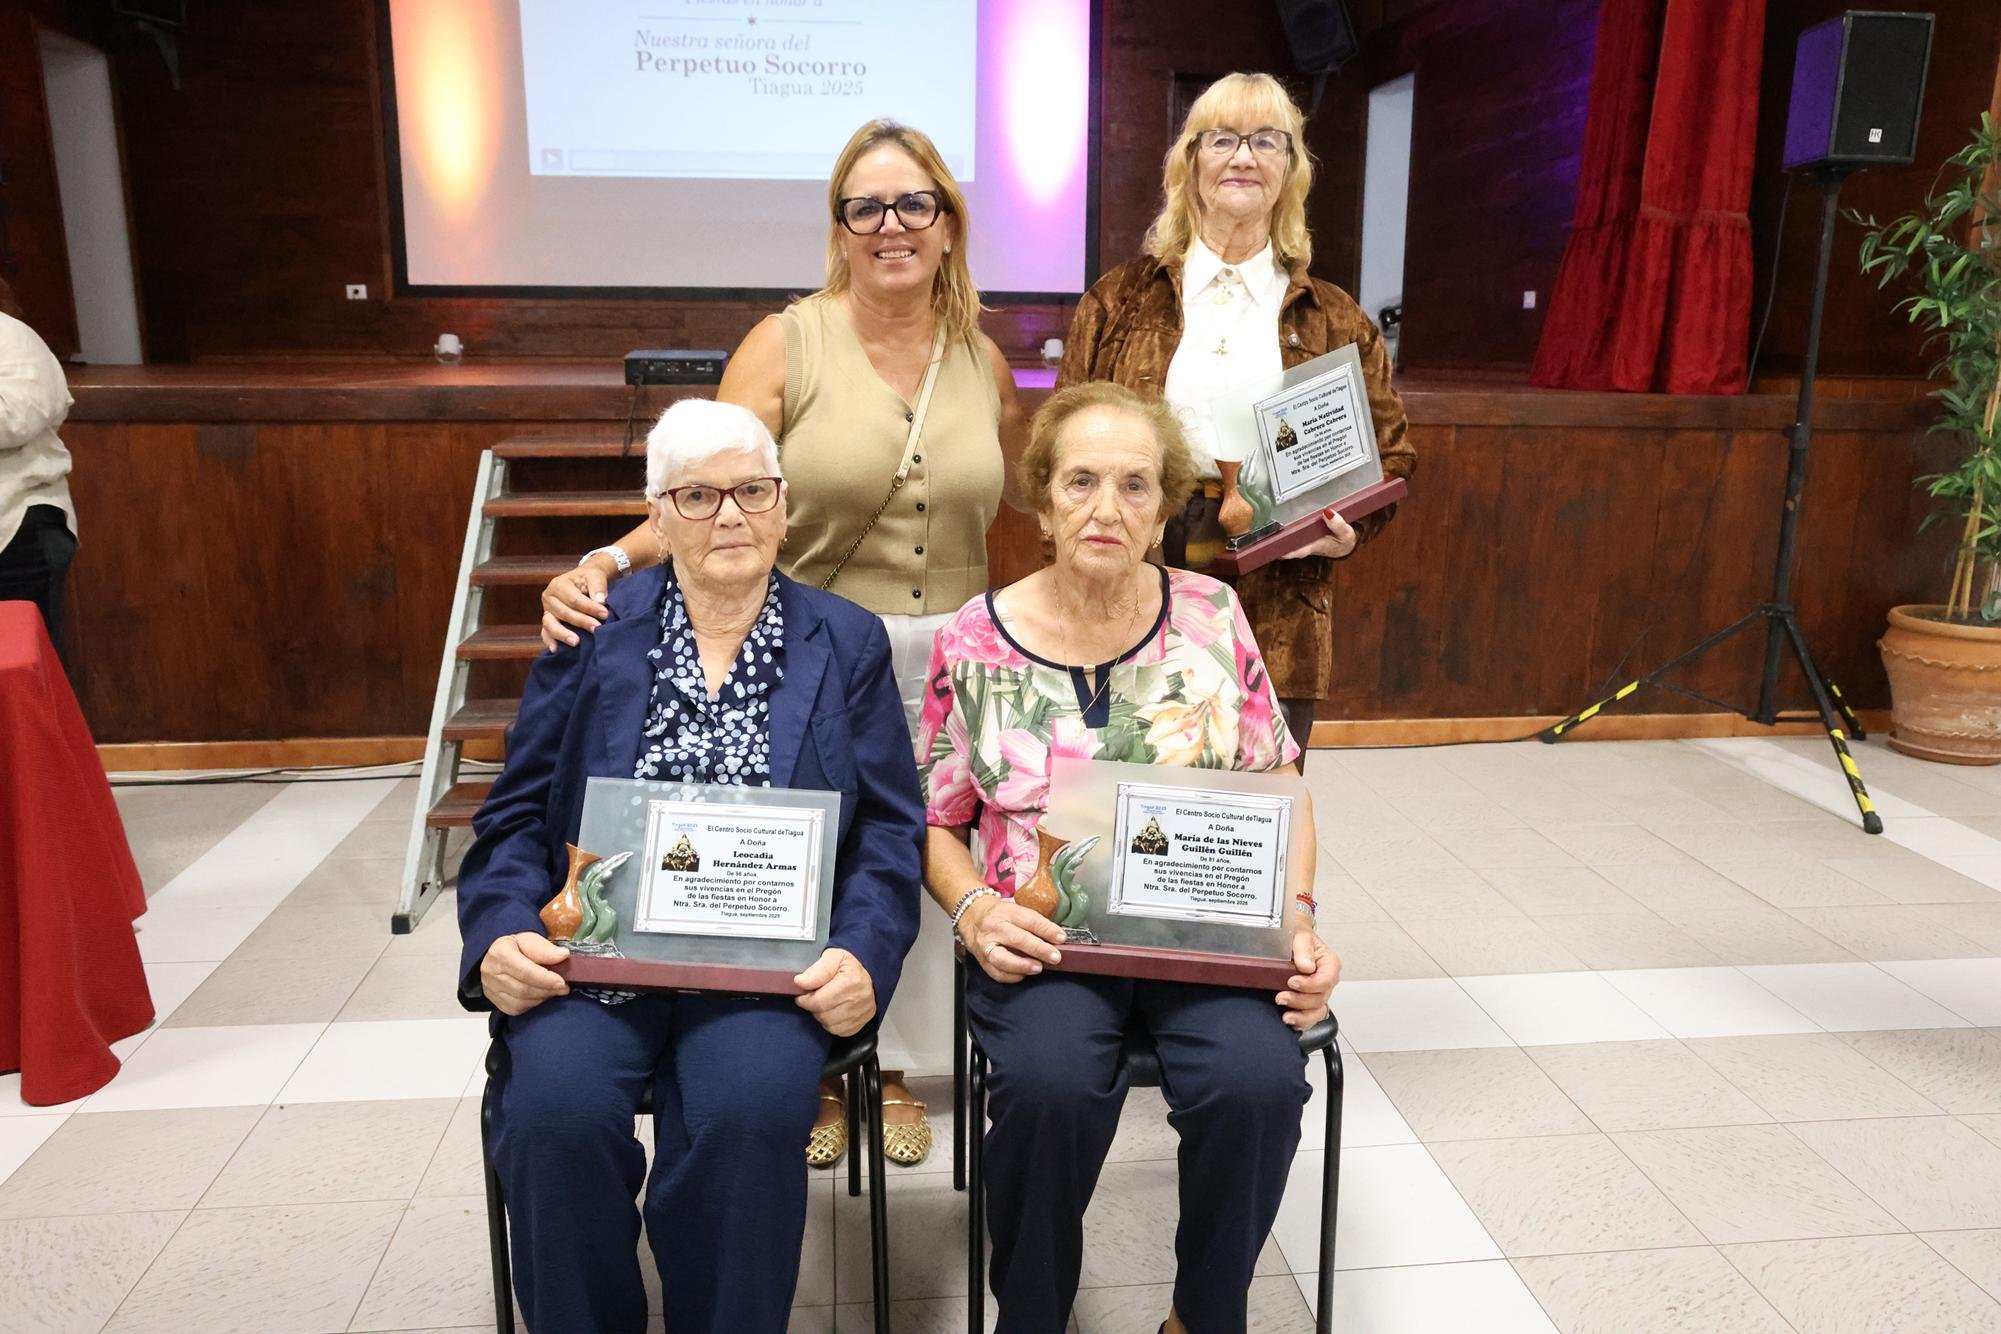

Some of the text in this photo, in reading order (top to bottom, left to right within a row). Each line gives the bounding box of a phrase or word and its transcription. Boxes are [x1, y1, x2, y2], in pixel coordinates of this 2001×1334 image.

[634, 30, 811, 51] Nuestra señora del
[635, 50, 867, 77] Perpetuo Socorro
[749, 77, 864, 98] Tiagua 2025
[1319, 406, 1344, 420] Natividad
[1304, 414, 1346, 435] Cabrera Cabrera
[1222, 812, 1244, 821] Cultural
[1217, 837, 1229, 845] las
[1232, 838, 1263, 848] Nieves
[733, 851, 773, 859] Leocadia
[1182, 844, 1252, 857] Guillén Guillén
[713, 860, 796, 871] Hernández Armas
[1155, 859, 1210, 870] agradecimiento
[1212, 864, 1224, 872] por
[1226, 865, 1262, 875] contarnos
[685, 876, 741, 886] agradecimiento
[1170, 869, 1203, 878] vivencias
[1224, 873, 1249, 882] Pregón
[1180, 878, 1203, 886] fiestas
[1217, 881, 1239, 890] Honor
[1192, 888, 1224, 897] Perpetuo
[1226, 891, 1257, 899] Socorro.
[723, 903, 756, 912] Perpetuo
